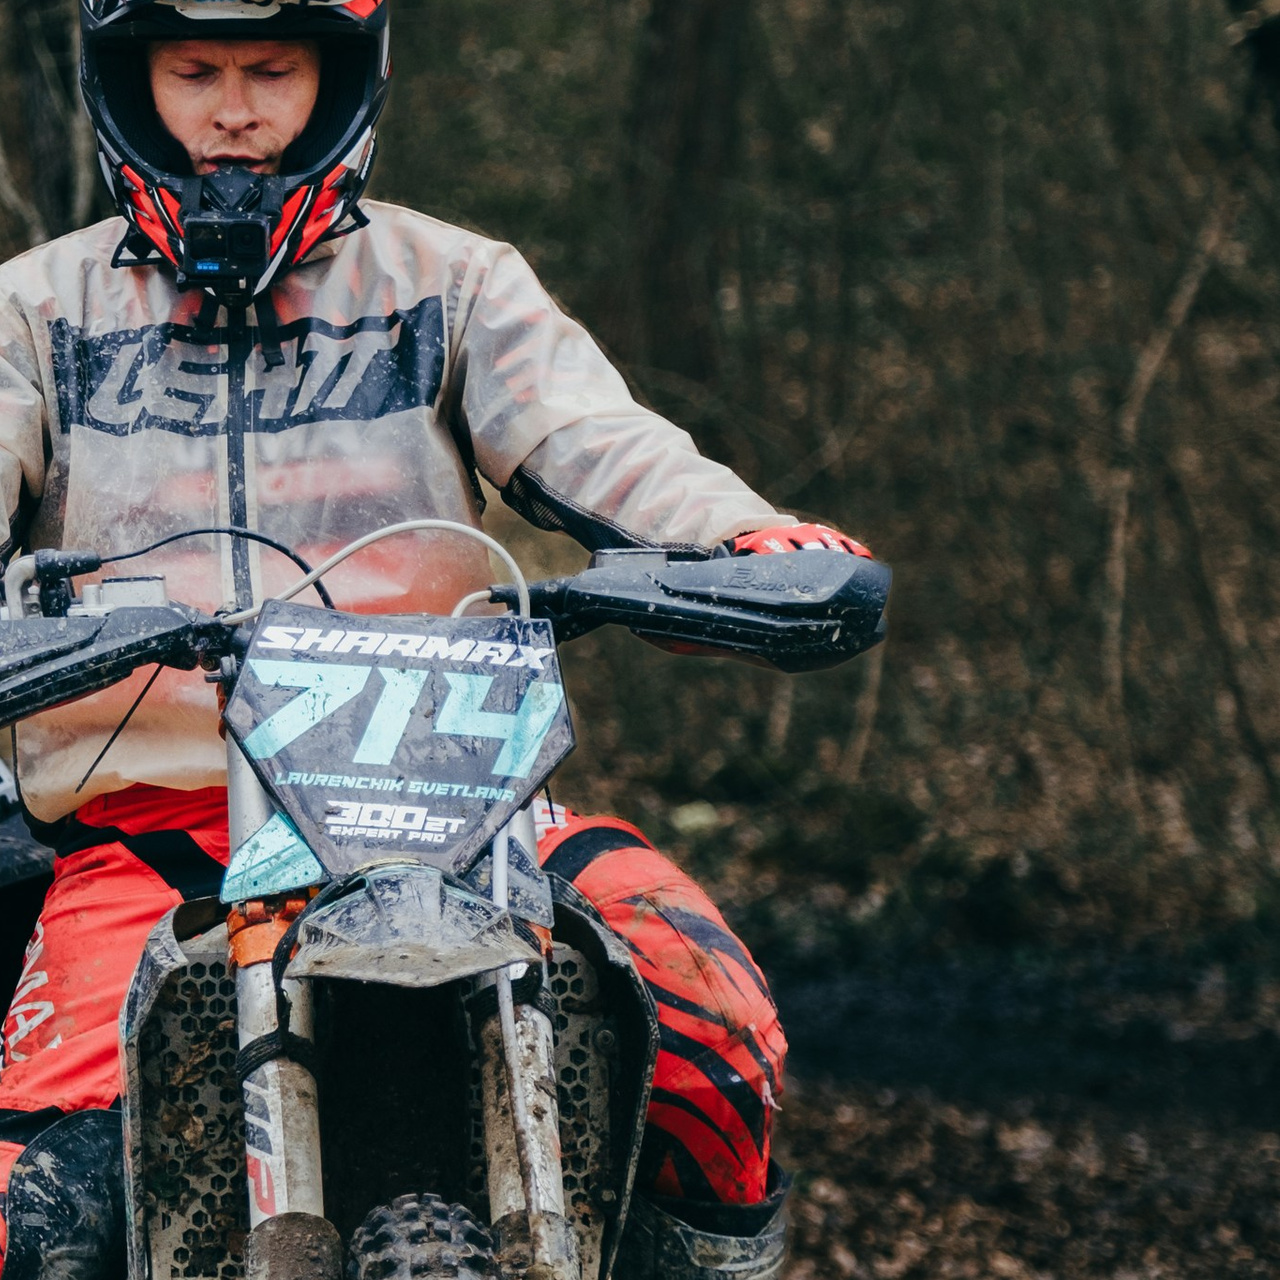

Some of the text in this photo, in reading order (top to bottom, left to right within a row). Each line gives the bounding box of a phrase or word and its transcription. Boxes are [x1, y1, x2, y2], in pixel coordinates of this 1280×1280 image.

[257, 625, 555, 670] SHARMAX
[243, 658, 564, 780] 714
[274, 772, 517, 803] LAVRENCHIK SVETLANA
[328, 826, 447, 843] EXPERT PRO
